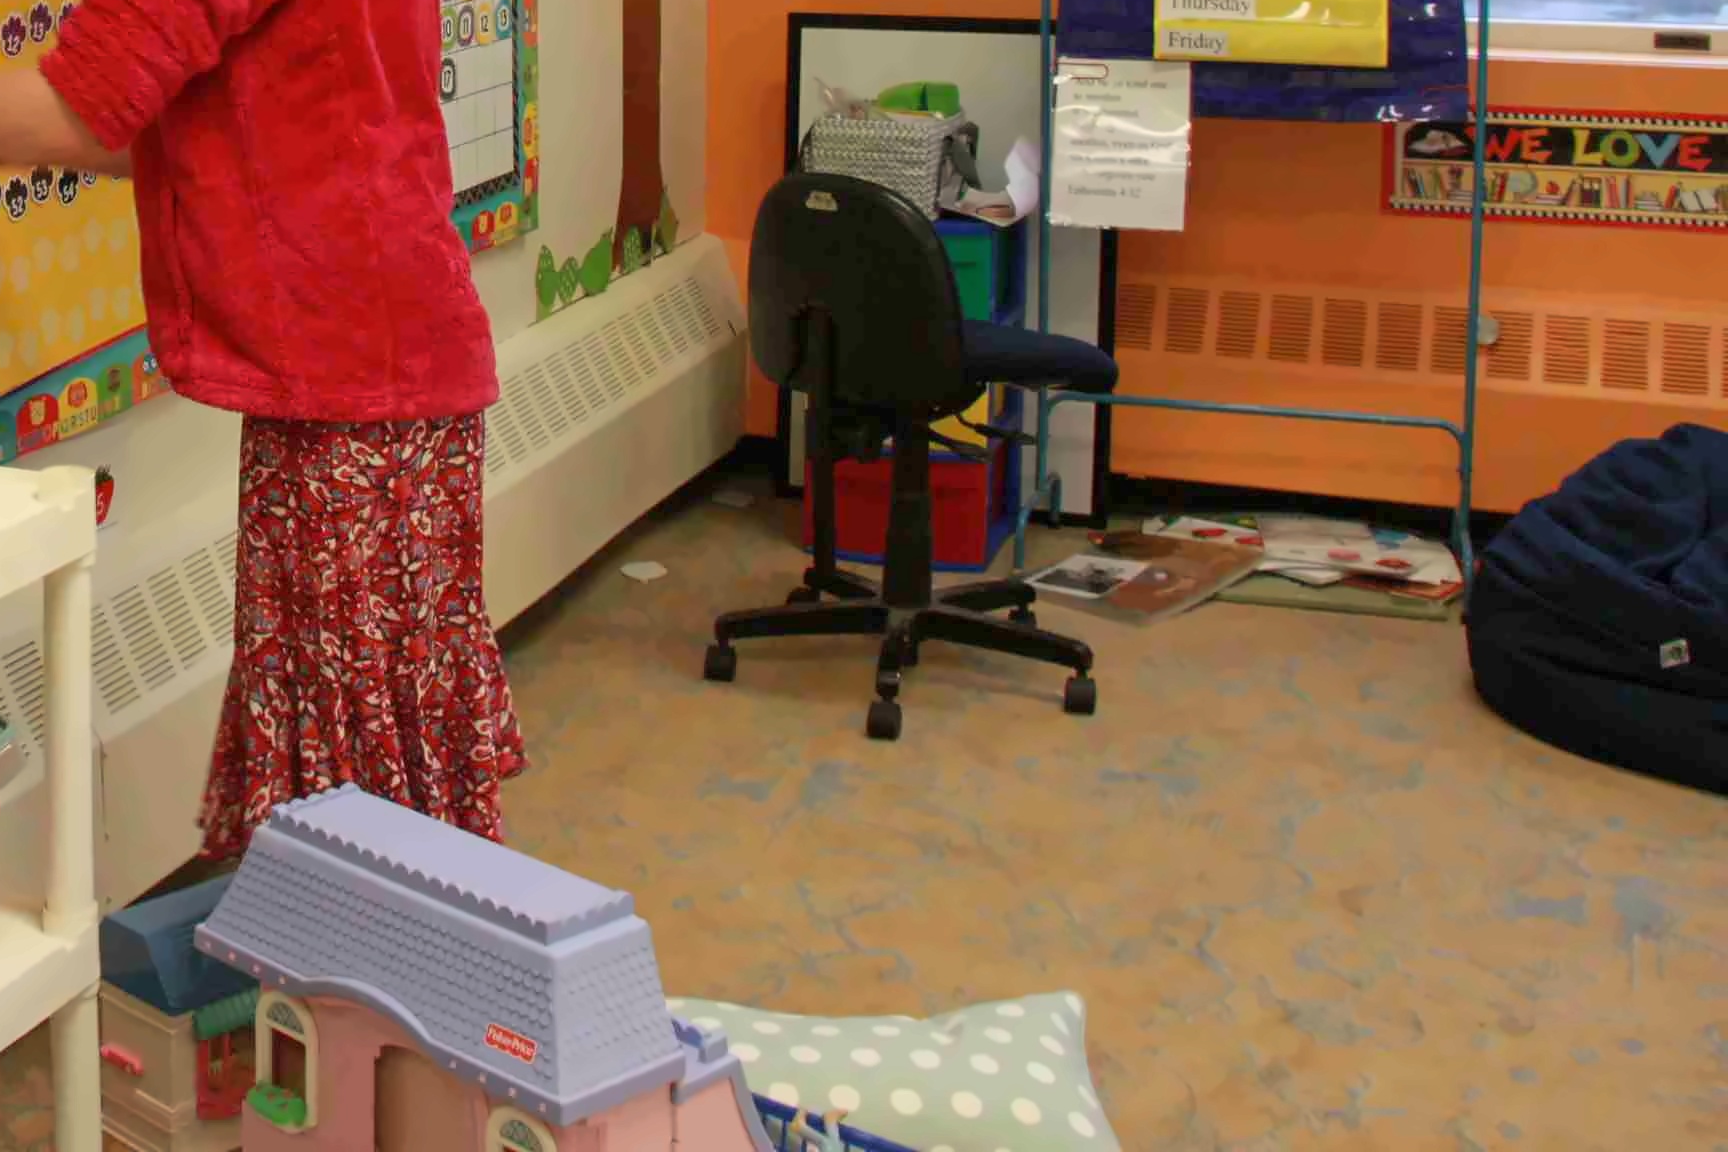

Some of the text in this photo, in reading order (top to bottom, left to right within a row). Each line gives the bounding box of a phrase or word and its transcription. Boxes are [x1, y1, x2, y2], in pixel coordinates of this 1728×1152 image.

[7, 34, 20, 52] 12
[34, 21, 44, 39] 13
[480, 14, 489, 33] 12
[1167, 30, 1226, 53] Friday
[1465, 126, 1713, 172] WE LOVE
[12, 195, 24, 216] 52
[35, 178, 48, 198] 53
[63, 183, 74, 202] 54
